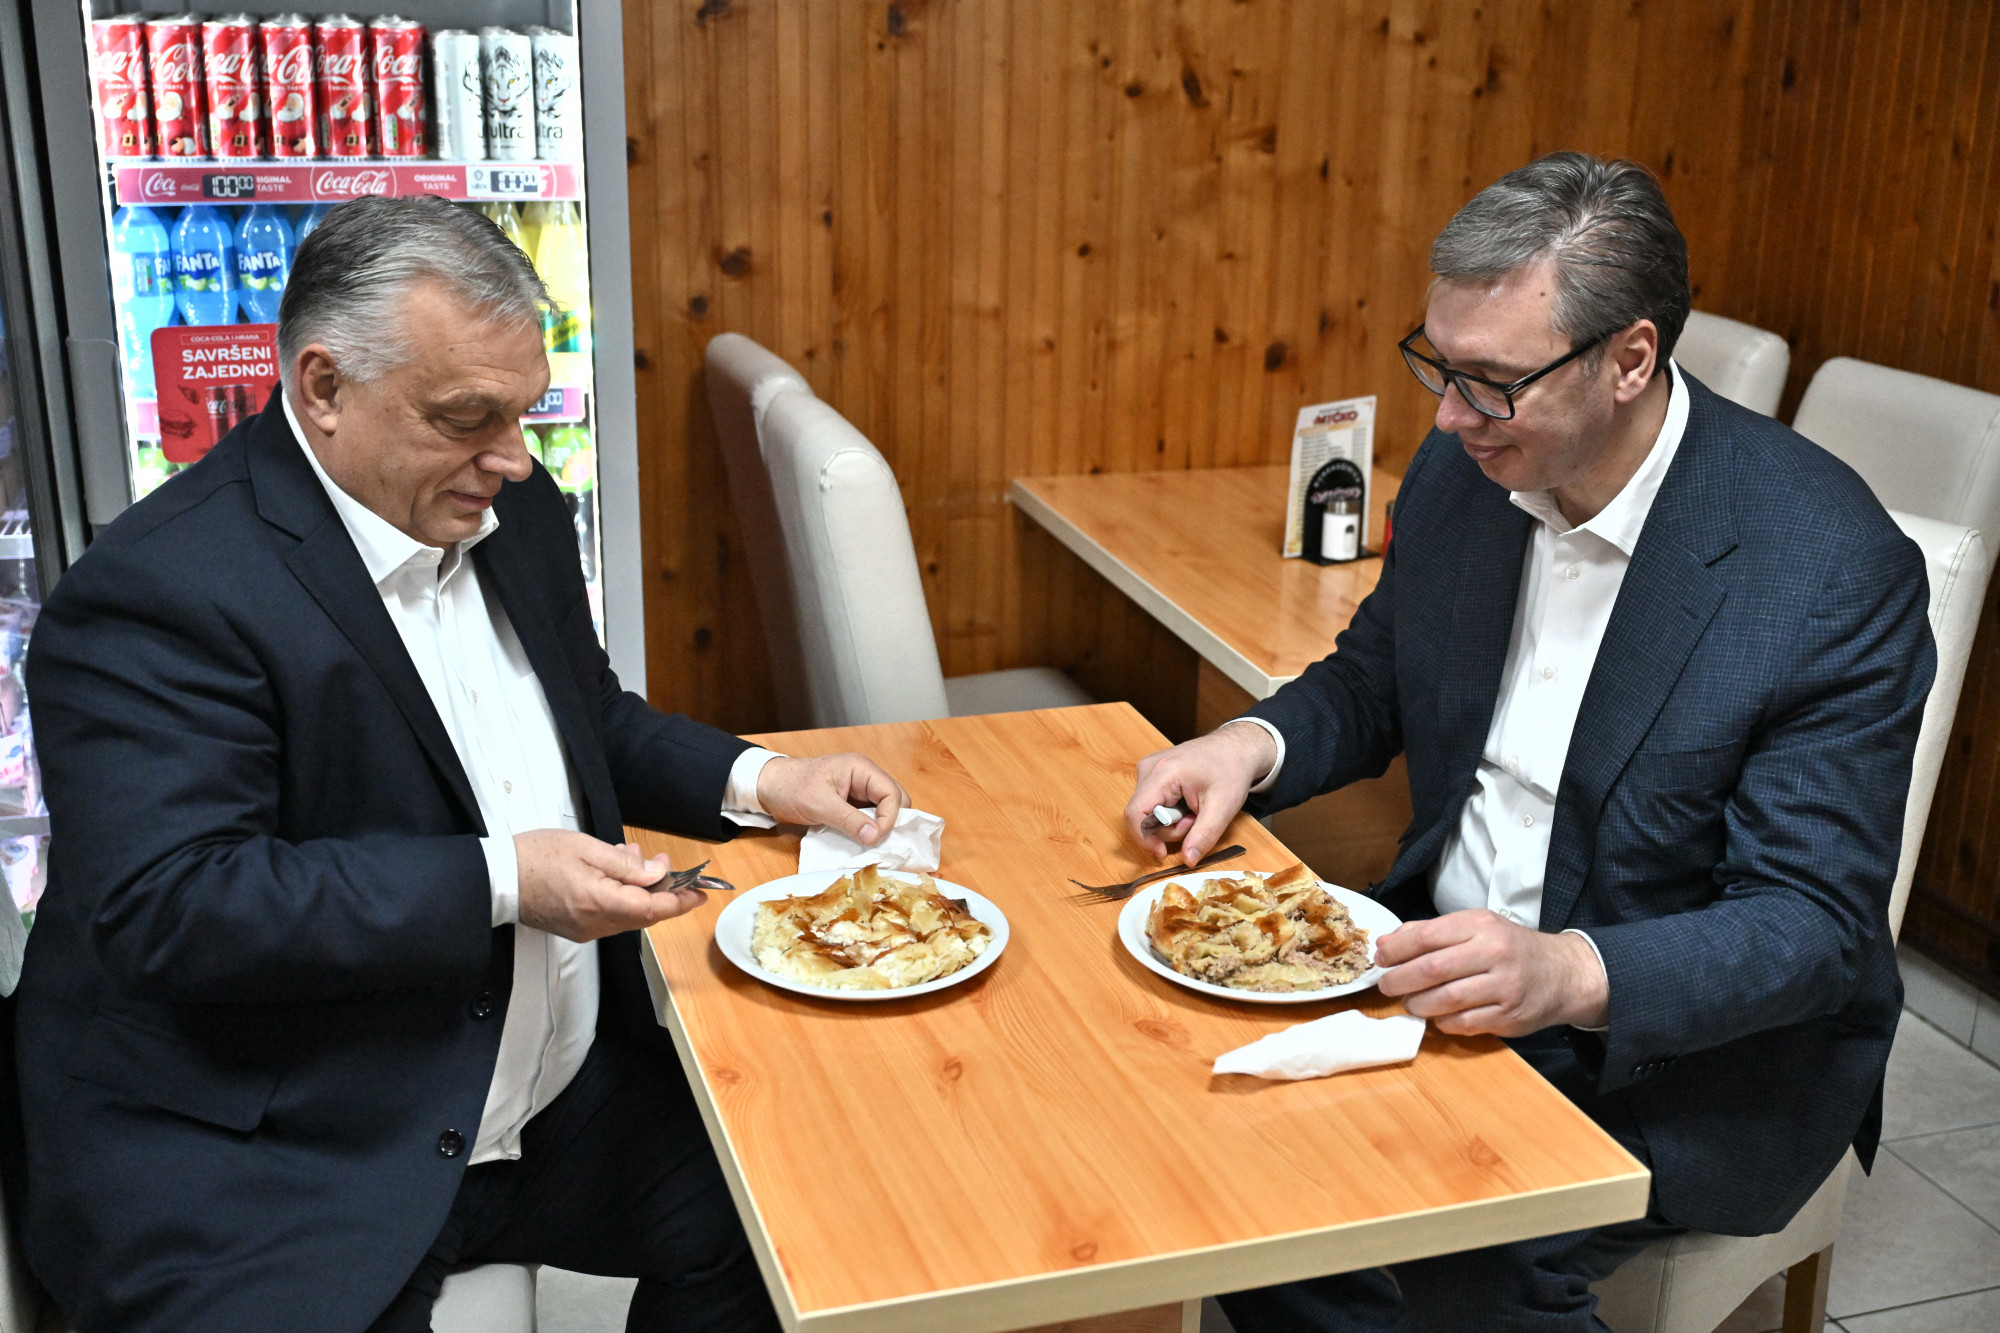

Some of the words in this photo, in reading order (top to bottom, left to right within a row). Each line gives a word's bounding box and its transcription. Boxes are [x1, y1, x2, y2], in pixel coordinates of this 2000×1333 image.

[315, 170, 390, 195] Coca-Cola
[413, 173, 458, 183] ORIGINAL
[423, 182, 450, 190] TASTE
[257, 183, 285, 192] TASTE
[175, 252, 220, 273] FANTA
[237, 251, 281, 272] FANTA
[182, 344, 271, 362] SAVRŠENI
[182, 363, 274, 379] ZAJEDNO!
